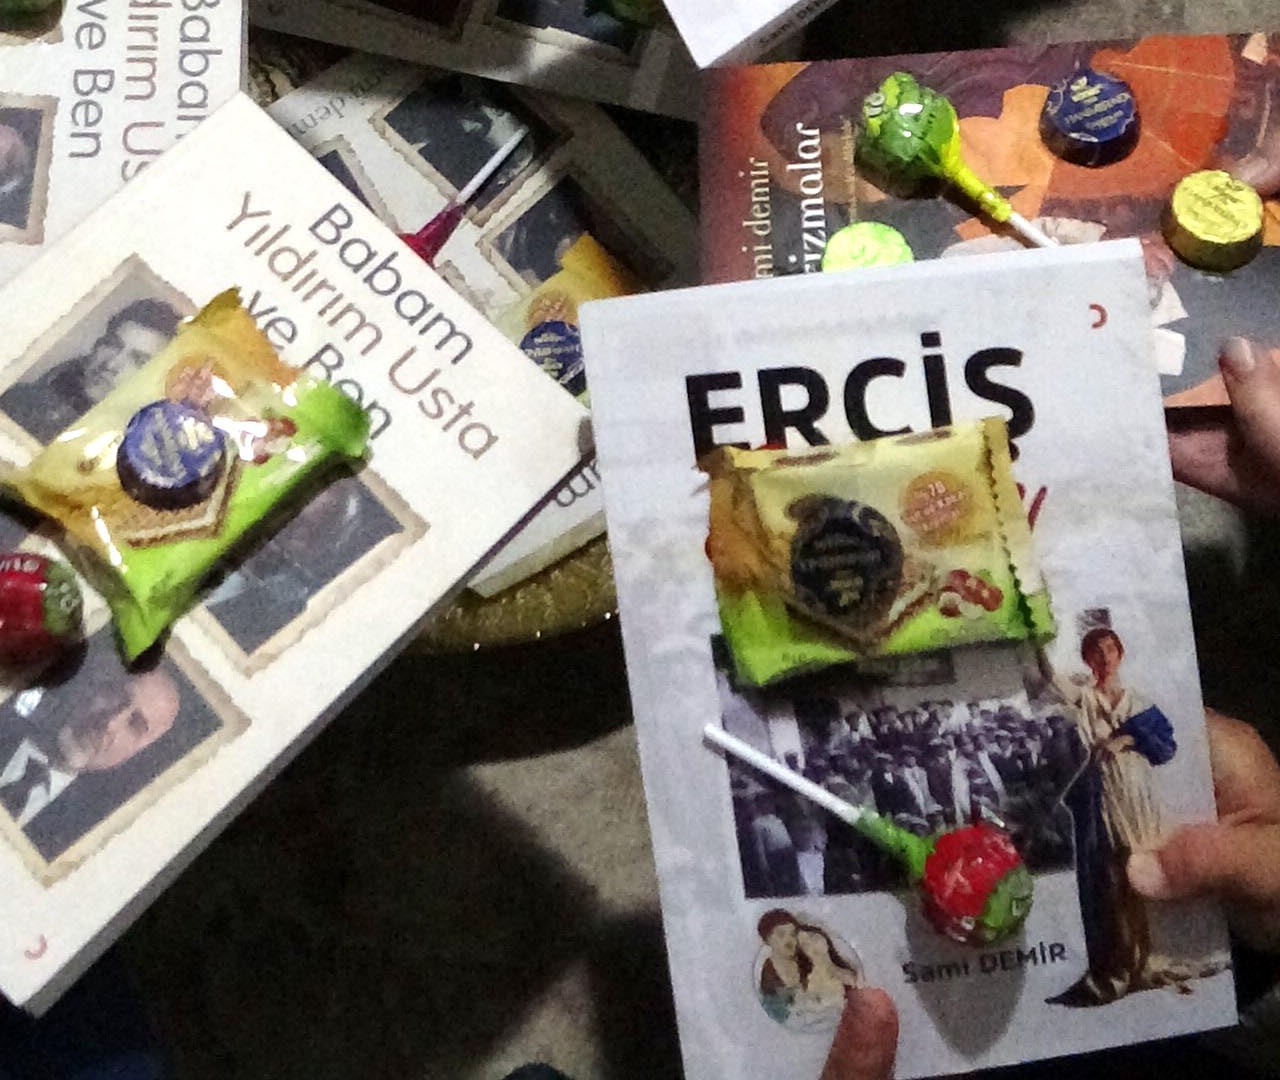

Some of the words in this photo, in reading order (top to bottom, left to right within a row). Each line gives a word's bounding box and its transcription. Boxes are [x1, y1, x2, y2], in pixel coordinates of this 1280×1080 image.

[68, 69, 115, 158] Ben
[288, 96, 345, 135] dem
[121, 120, 165, 182] Us
[738, 157, 772, 236] demir
[308, 203, 473, 365] Babam
[741, 245, 773, 278] mi
[227, 191, 383, 357] Yıldırım
[389, 346, 499, 460] Usta
[247, 290, 298, 351] ve
[902, 958, 969, 984] Sami
